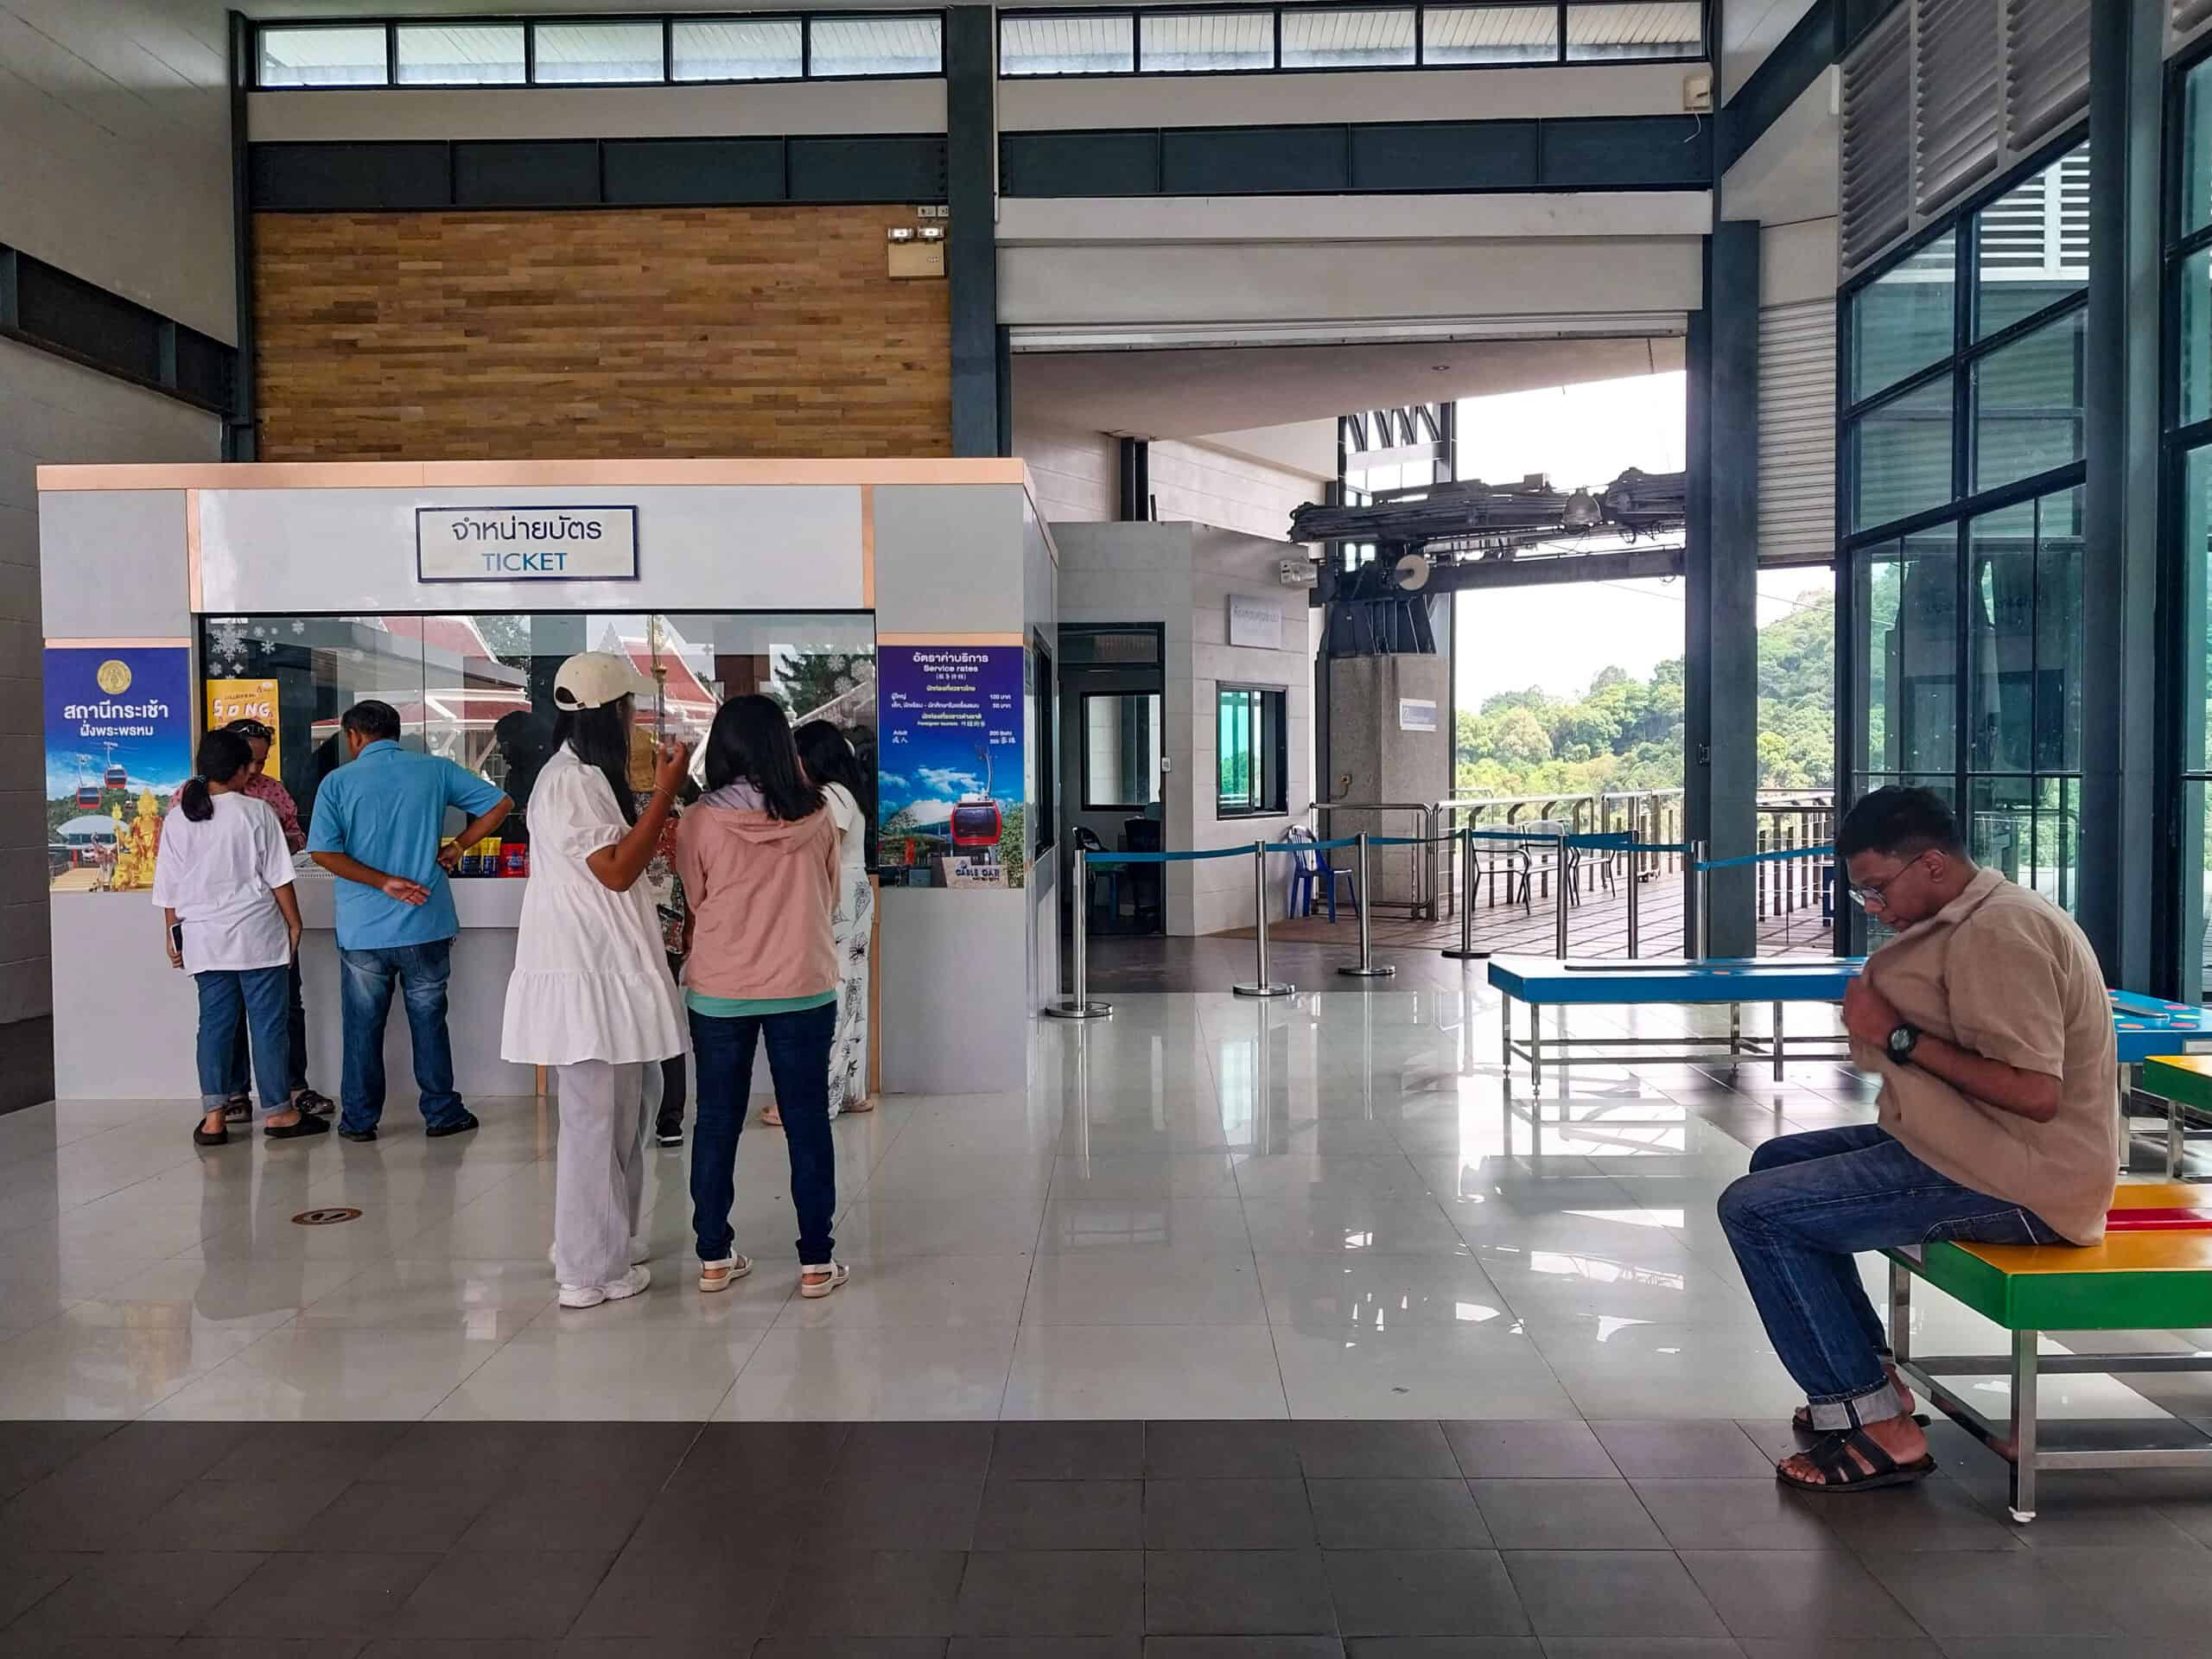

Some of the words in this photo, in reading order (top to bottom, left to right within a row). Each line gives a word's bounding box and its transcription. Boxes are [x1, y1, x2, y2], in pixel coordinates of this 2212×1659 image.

[452, 515, 602, 541] จำหน่ายบัตร
[481, 552, 568, 571] TICKET
[912, 652, 988, 663] อัตราค่าบริการ
[64, 699, 168, 719] สถานีกระเช้า
[79, 720, 154, 736] ฝั่งพระพรหม
